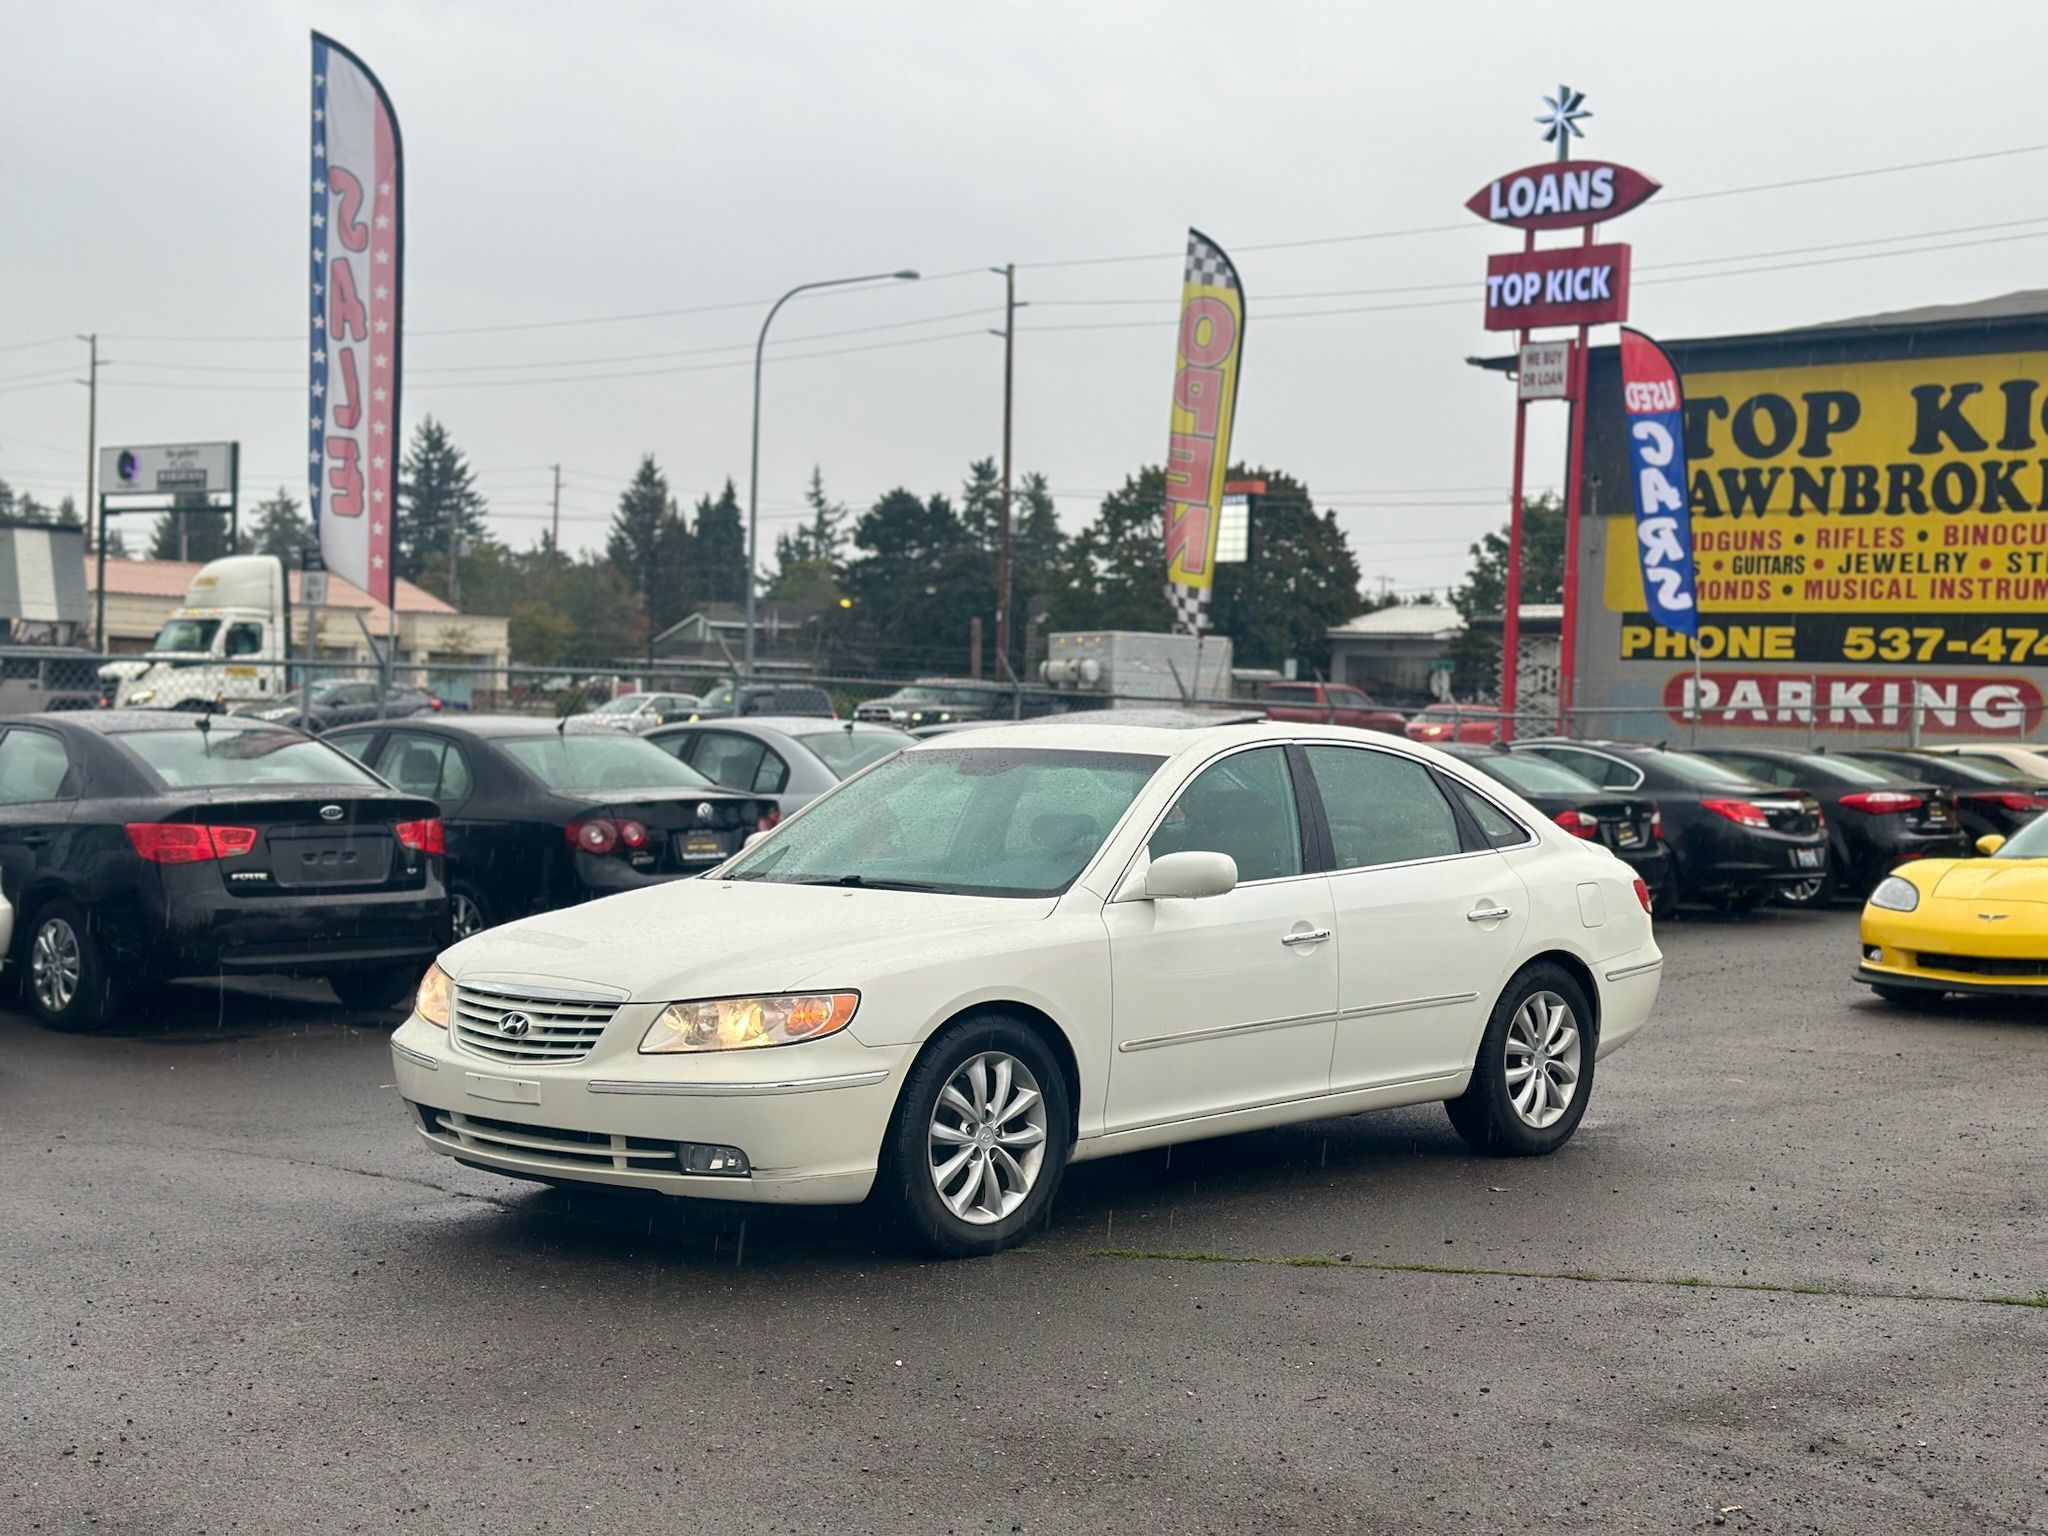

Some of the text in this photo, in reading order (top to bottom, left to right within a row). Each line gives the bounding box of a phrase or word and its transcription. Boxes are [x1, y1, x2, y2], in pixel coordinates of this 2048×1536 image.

[1489, 167, 1614, 219] LOANS
[1487, 266, 1612, 308] TOP KICK
[1527, 351, 1563, 366] WE BUY
[1523, 372, 1563, 387] OR LOAN
[1685, 380, 2048, 460] TOP KI
[1816, 527, 1905, 549] RIFLES
[1732, 552, 2048, 575] GUITARS JEWELRY ST
[1804, 578, 1918, 601] MUSICAL
[1621, 625, 1797, 659] PHONE
[1683, 677, 2025, 729] PARKING
